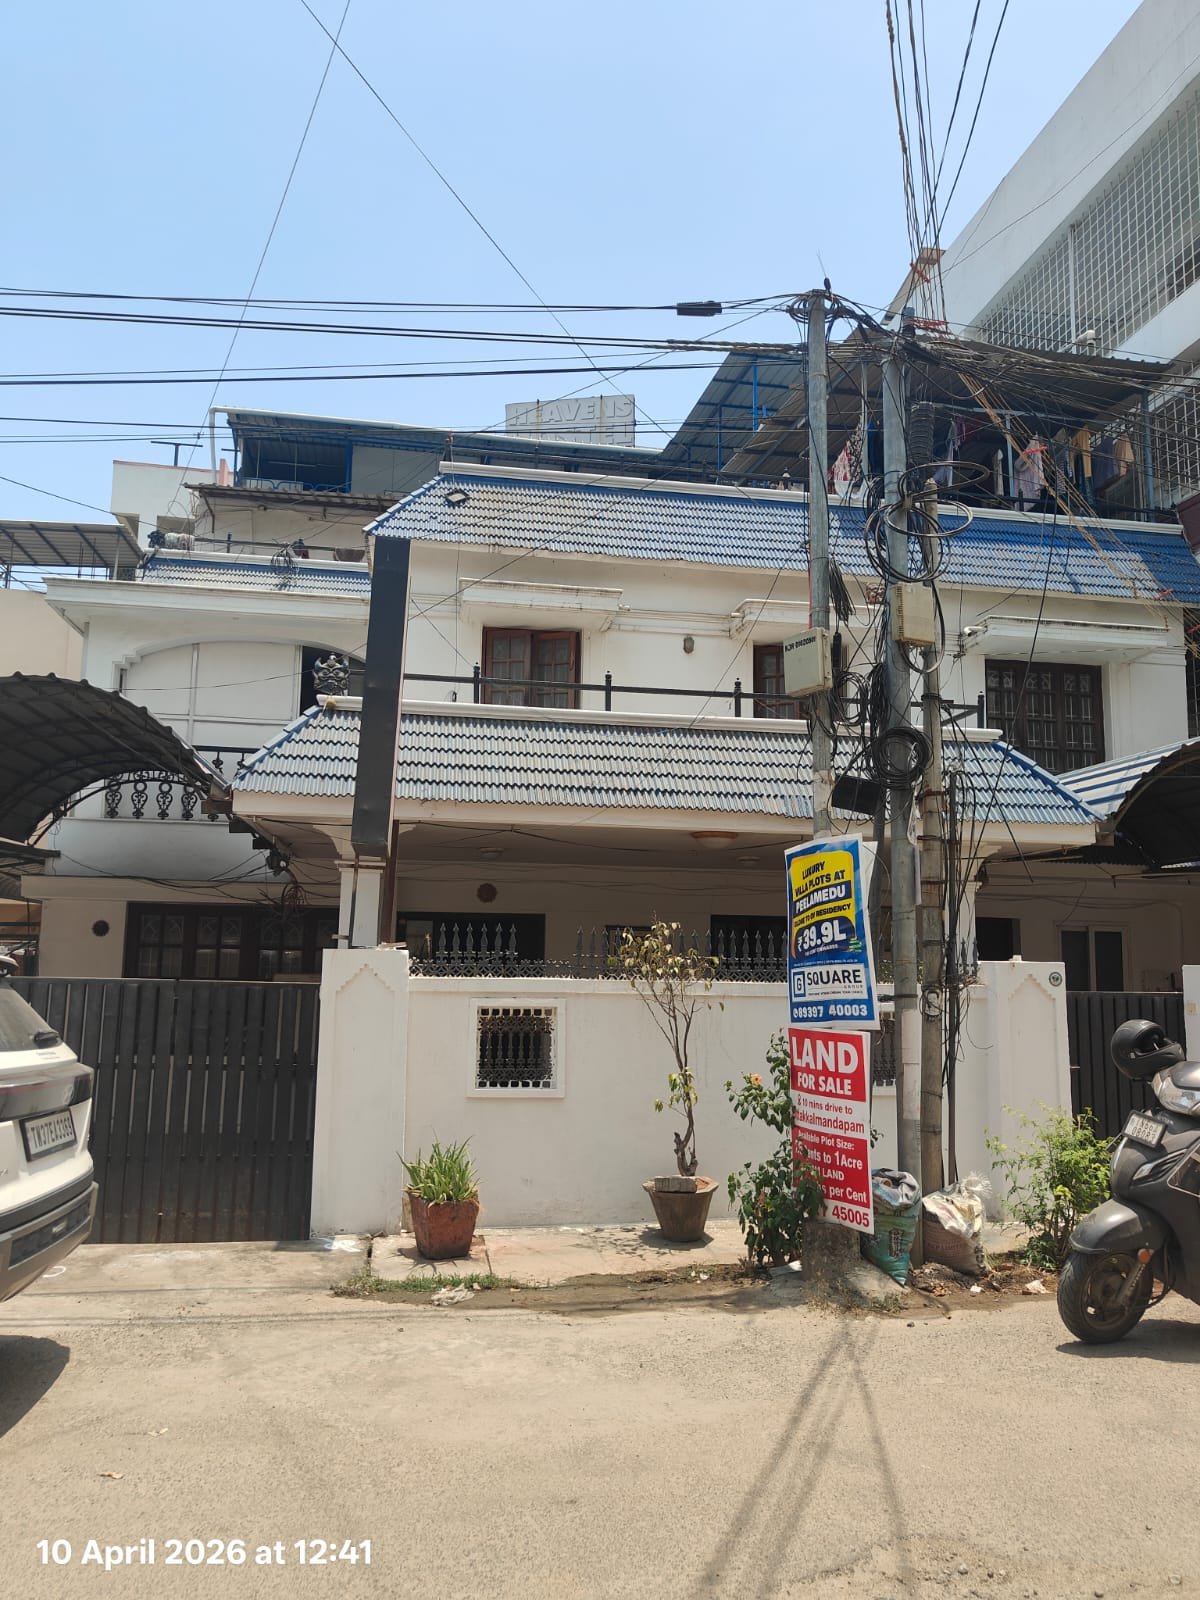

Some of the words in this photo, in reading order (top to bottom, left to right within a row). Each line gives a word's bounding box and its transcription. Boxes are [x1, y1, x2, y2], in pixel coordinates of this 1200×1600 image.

[802, 861, 825, 880] LUXURY
[794, 882, 809, 898] VILLA
[808, 873, 831, 888] PLOTS
[834, 869, 845, 881] AT
[795, 884, 846, 914] PEELAMEDU
[815, 902, 851, 917] RESIDENCY
[806, 969, 863, 986] SQUARE
[798, 1005, 824, 1018] 89397
[829, 1004, 868, 1017] 40003
[791, 1036, 859, 1075] LAND
[797, 1071, 816, 1090] FOR
[818, 1077, 852, 1096] SALE
[808, 1100, 823, 1111] mins
[824, 1102, 843, 1114] drive
[845, 1103, 853, 1115] to
[820, 1135, 835, 1148] Plot
[836, 1138, 855, 1151] Size:
[823, 1151, 832, 1164] to
[822, 1167, 845, 1181] LAND
[829, 1186, 844, 1198] per
[846, 1187, 867, 1203] Cent
[832, 1205, 870, 1228] 45005
